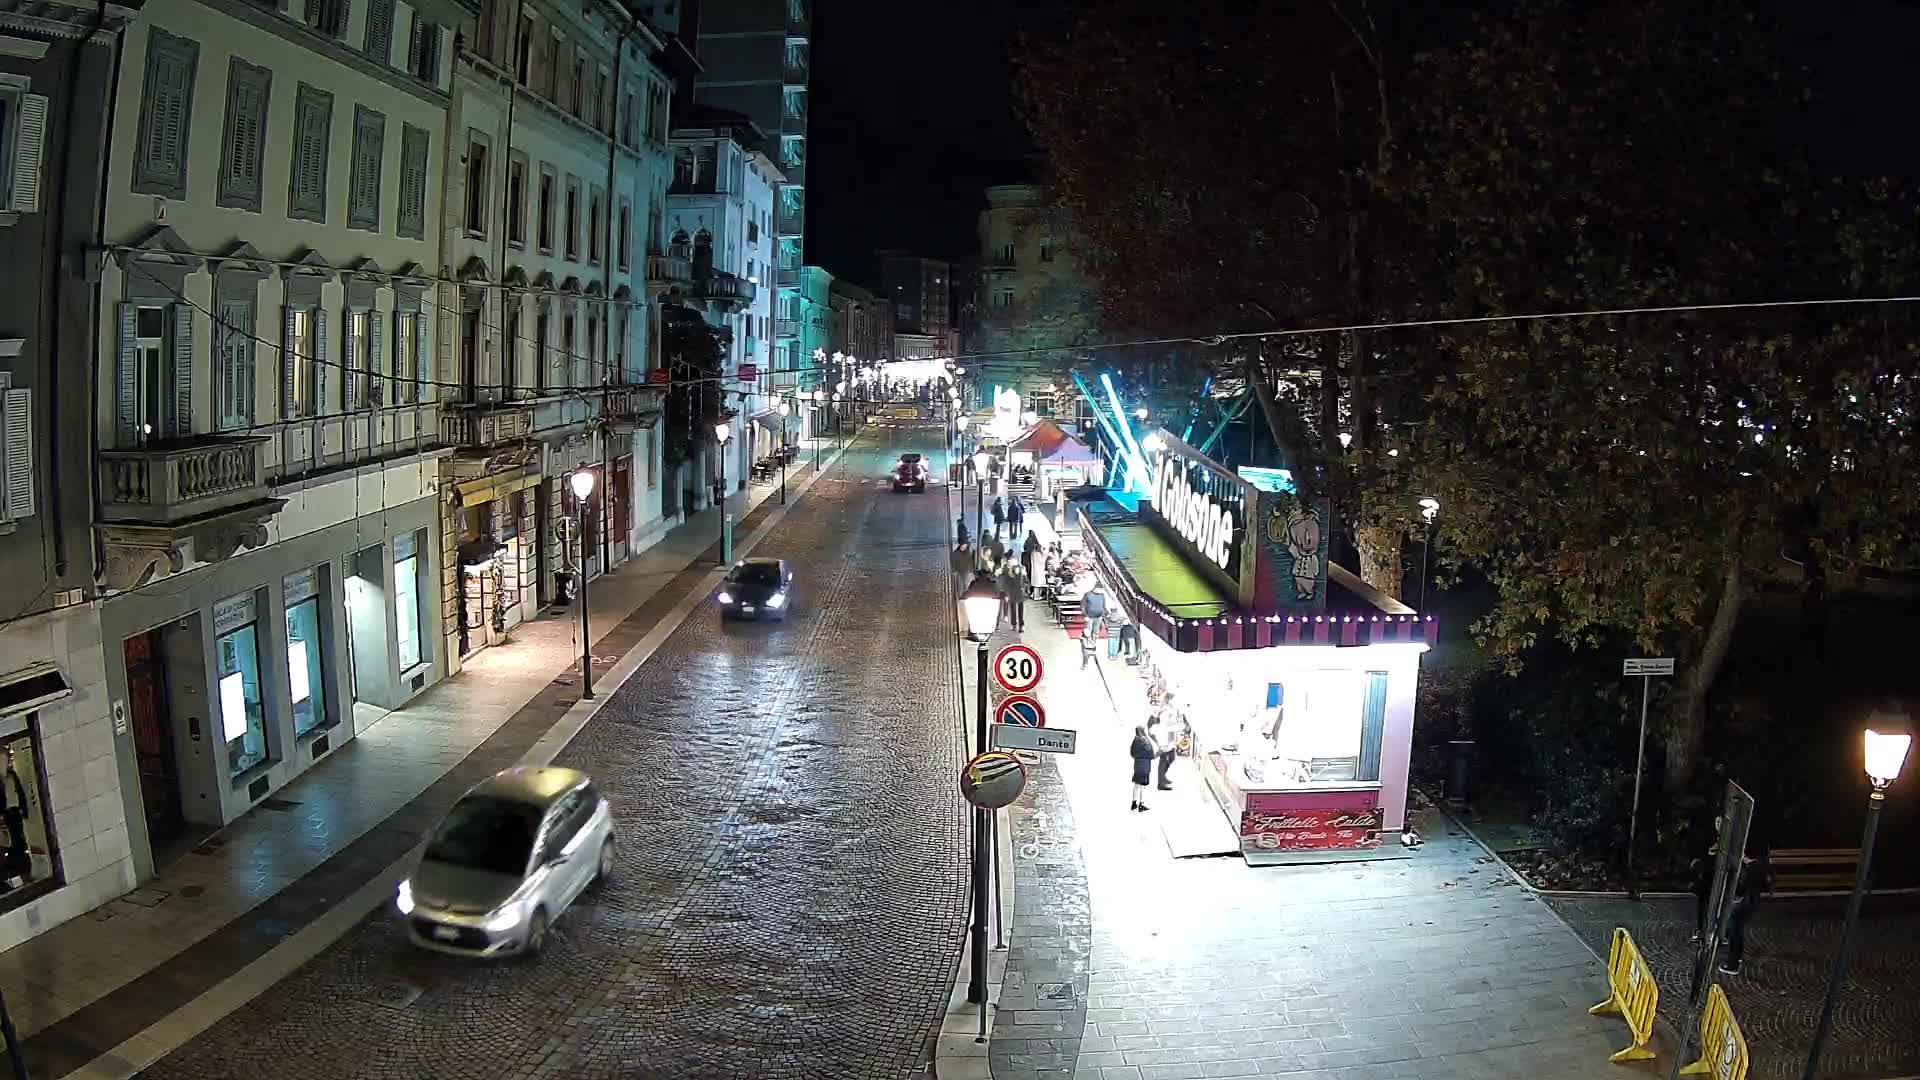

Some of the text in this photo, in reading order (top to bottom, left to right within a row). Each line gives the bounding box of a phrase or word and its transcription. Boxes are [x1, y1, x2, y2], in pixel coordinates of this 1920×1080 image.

[1161, 456, 1233, 569] Golosone
[1006, 658, 1032, 680] 30
[1038, 737, 1069, 749] Dante
